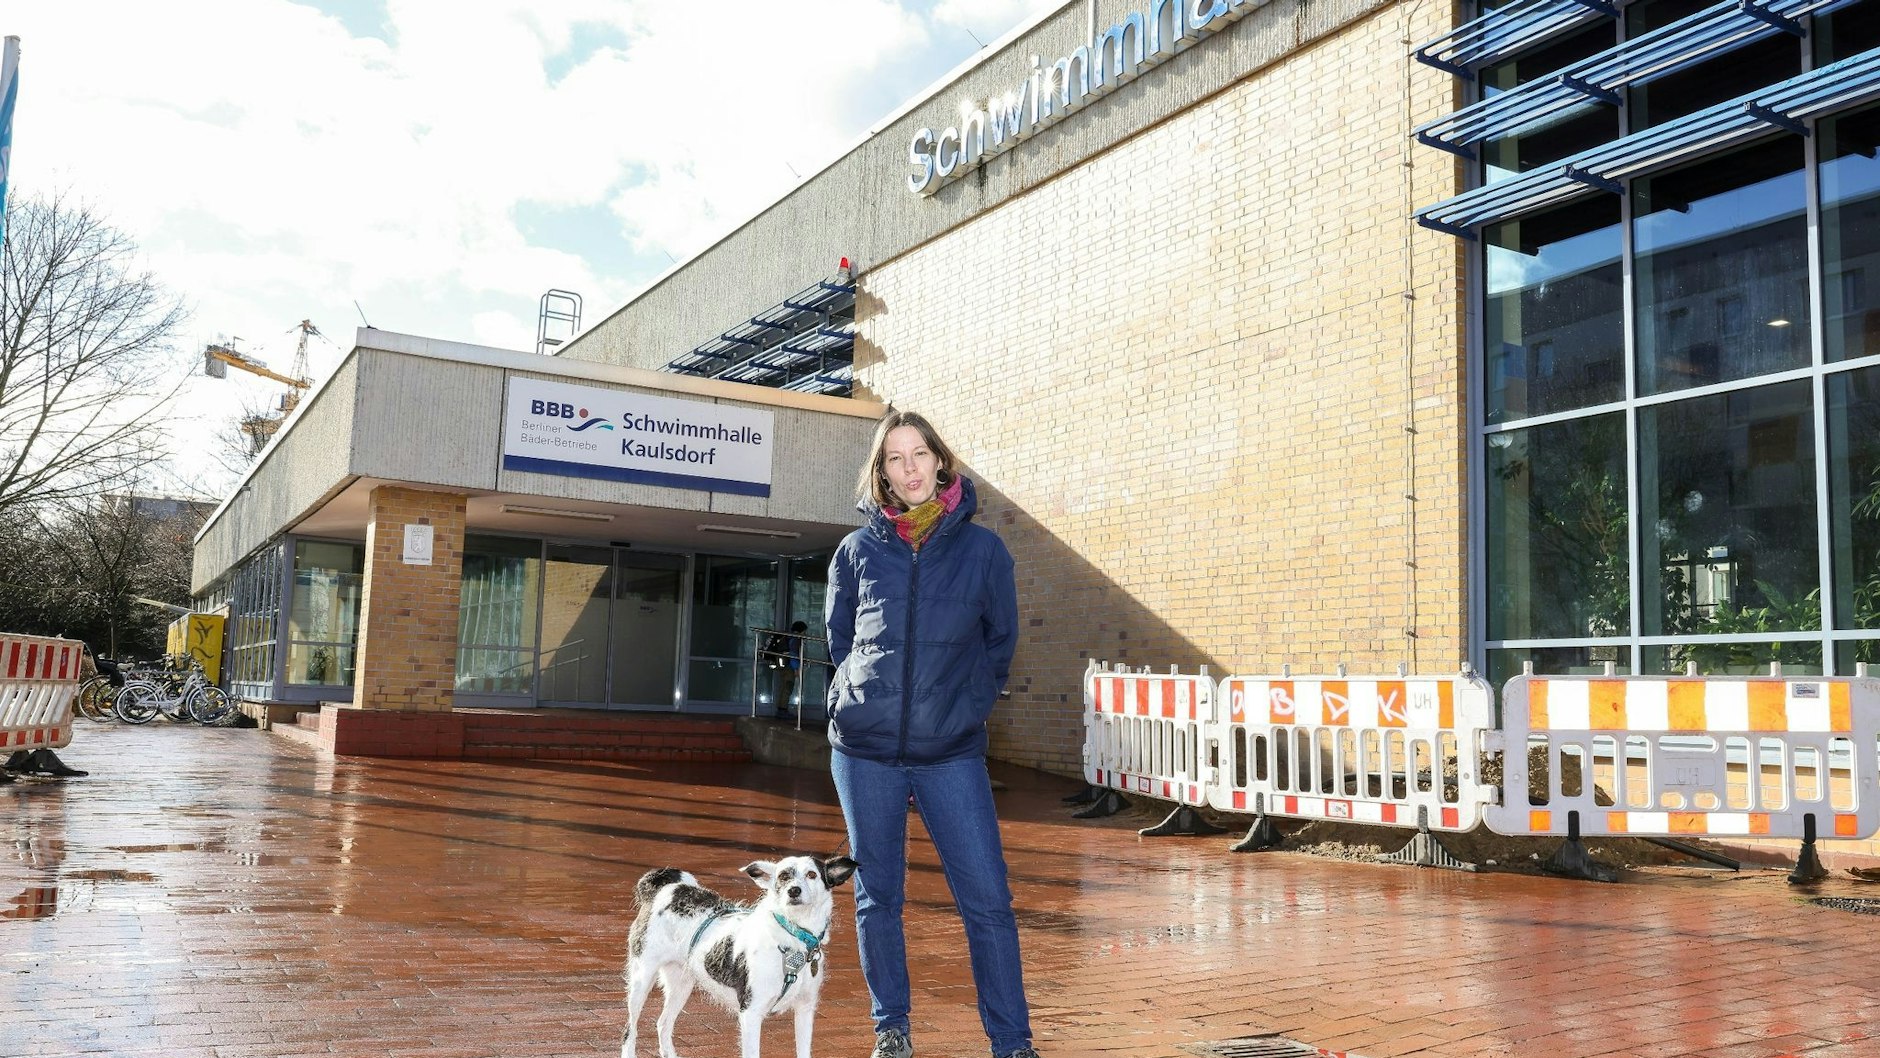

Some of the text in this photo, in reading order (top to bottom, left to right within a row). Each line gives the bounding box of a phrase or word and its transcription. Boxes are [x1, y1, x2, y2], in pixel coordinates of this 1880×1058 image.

[908, 0, 1245, 194] Schwimmha
[531, 399, 575, 419] BBB
[521, 419, 562, 434] Berliner
[622, 412, 762, 445] Schwimmhalle
[520, 432, 598, 451] Bäder-Betriebe
[621, 438, 716, 465] Kaulsdorf
